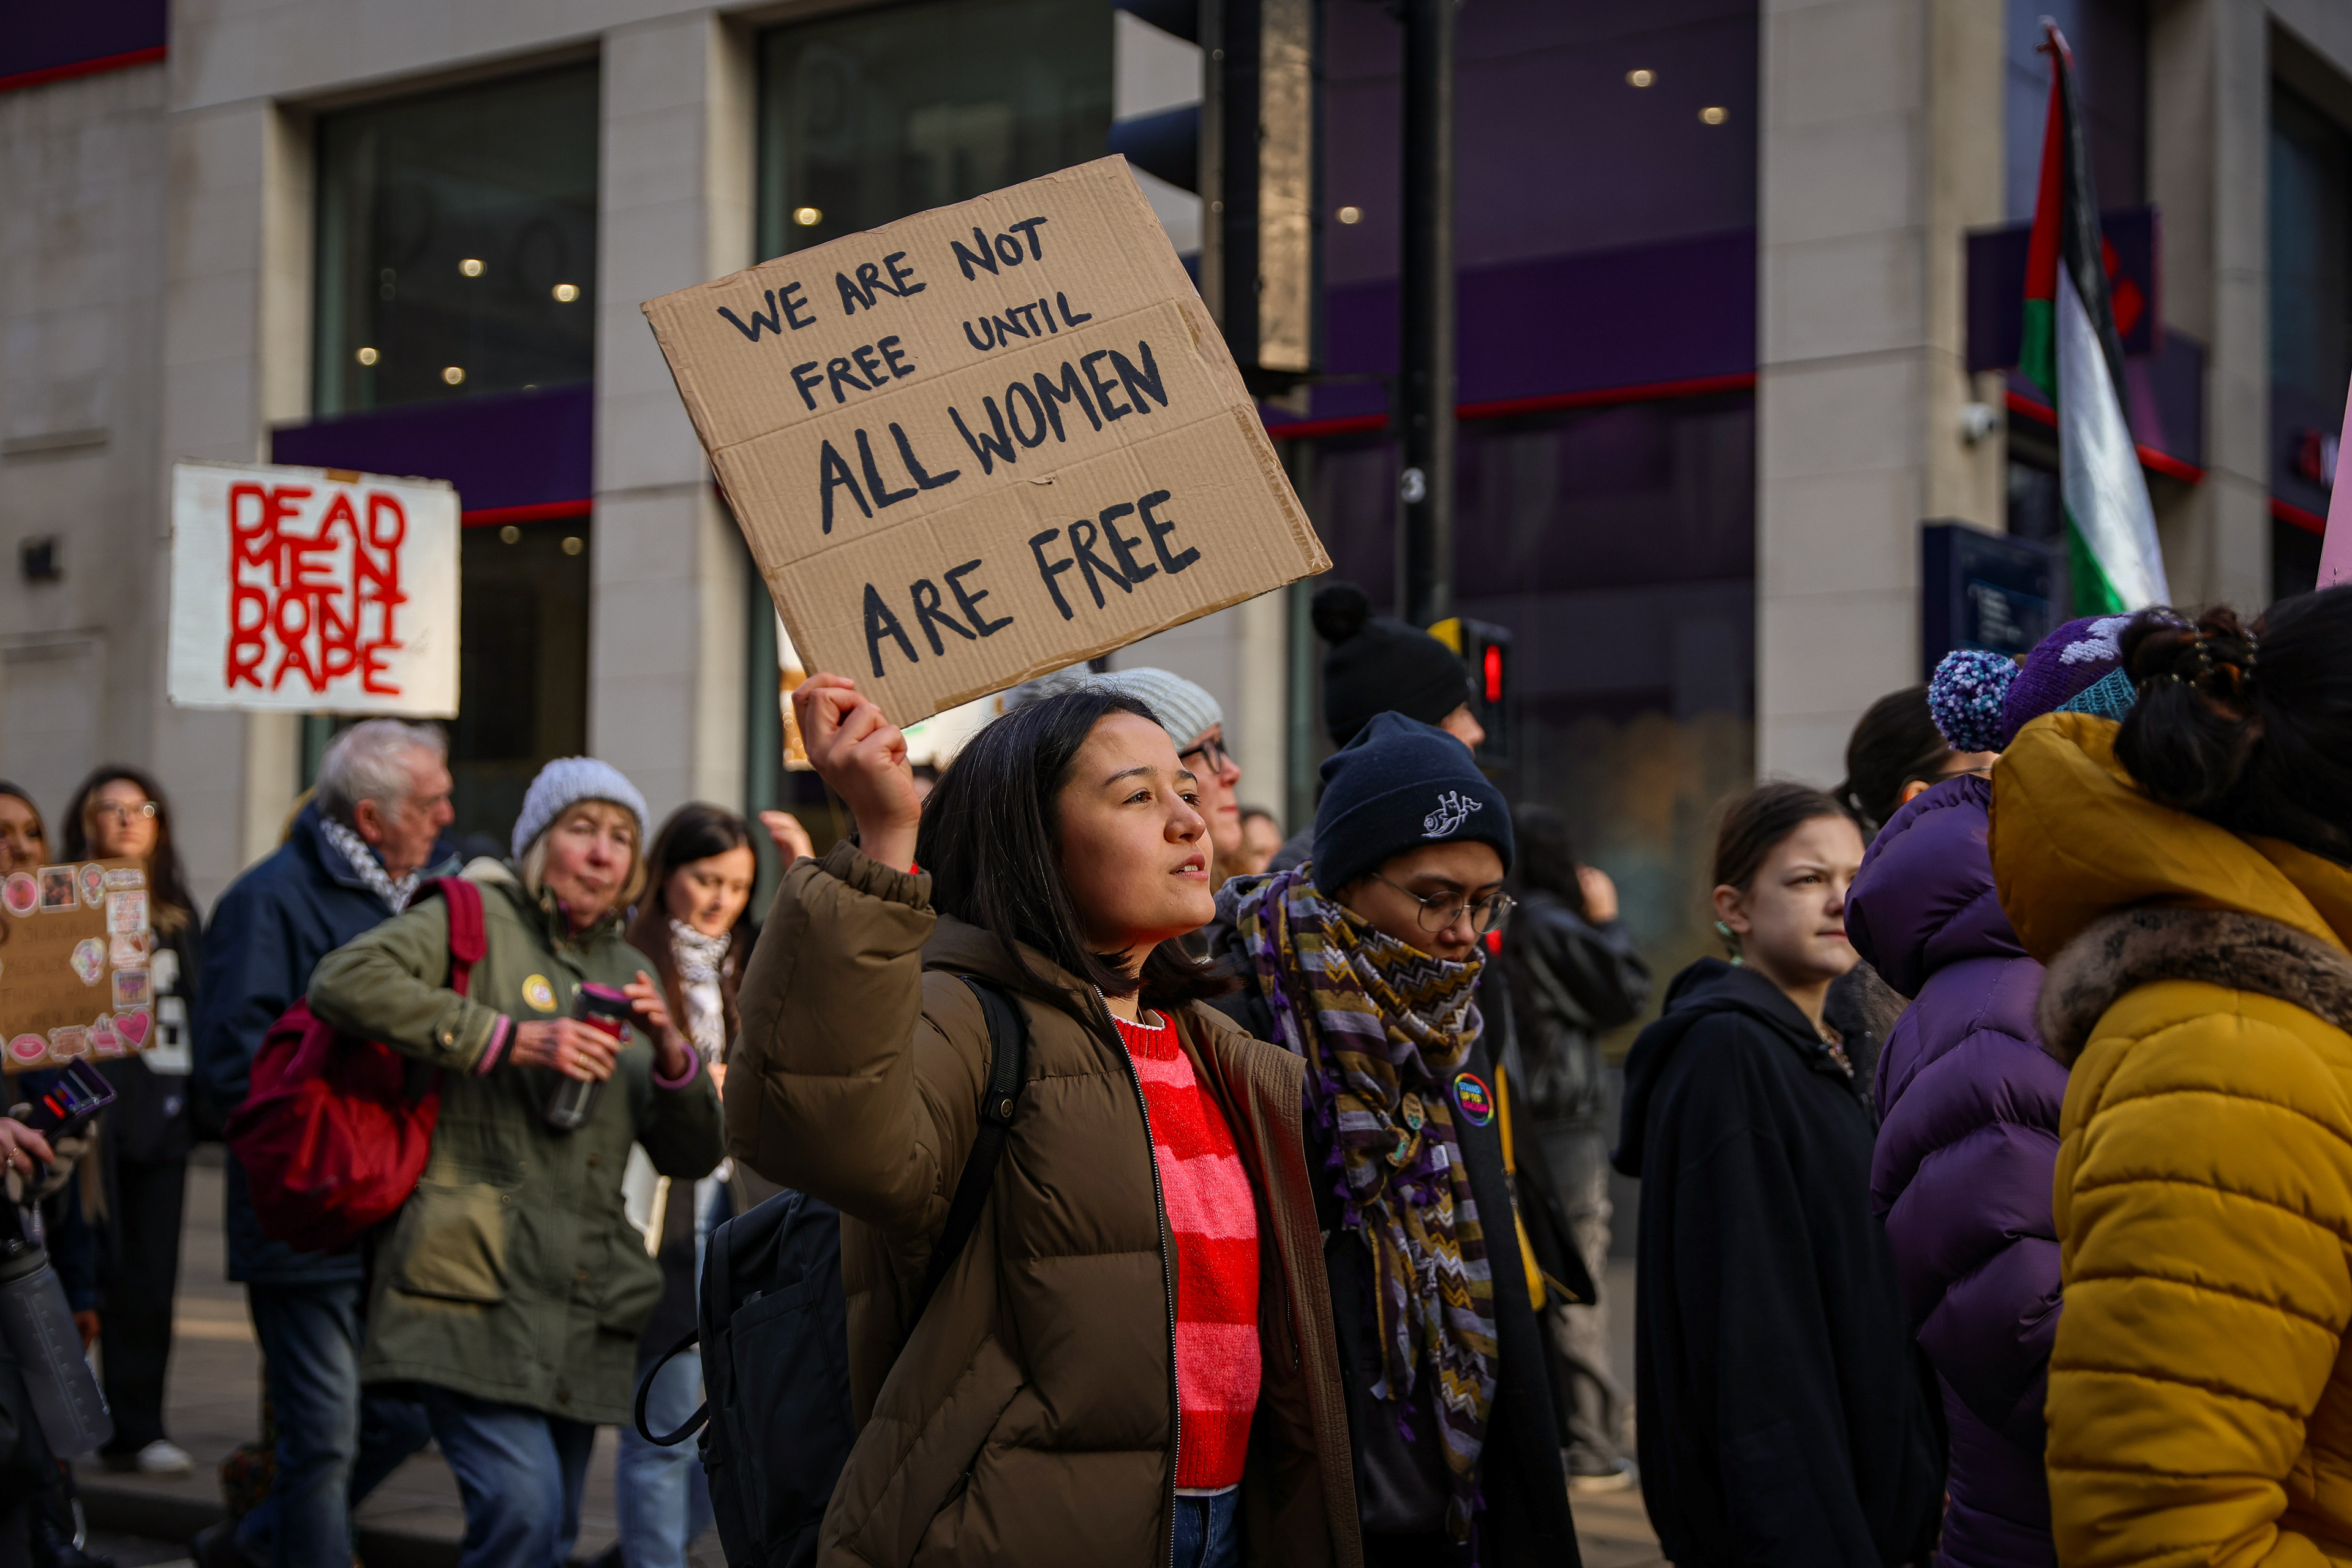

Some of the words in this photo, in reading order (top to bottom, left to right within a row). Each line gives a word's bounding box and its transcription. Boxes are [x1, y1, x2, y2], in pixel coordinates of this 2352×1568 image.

[715, 281, 818, 343] WE
[835, 251, 927, 316] ARE
[949, 216, 1049, 282] NOT
[789, 334, 916, 412] FREE
[962, 290, 1093, 352] UNTIL
[819, 421, 962, 535] ALL
[946, 339, 1169, 476] WOMEN
[230, 483, 405, 551] DEAD
[230, 532, 399, 595] MEN
[862, 558, 1014, 676] ARE
[1027, 489, 1202, 622] FREE
[227, 637, 403, 695] RAPE
[1458, 1082, 1482, 1095] STAND
